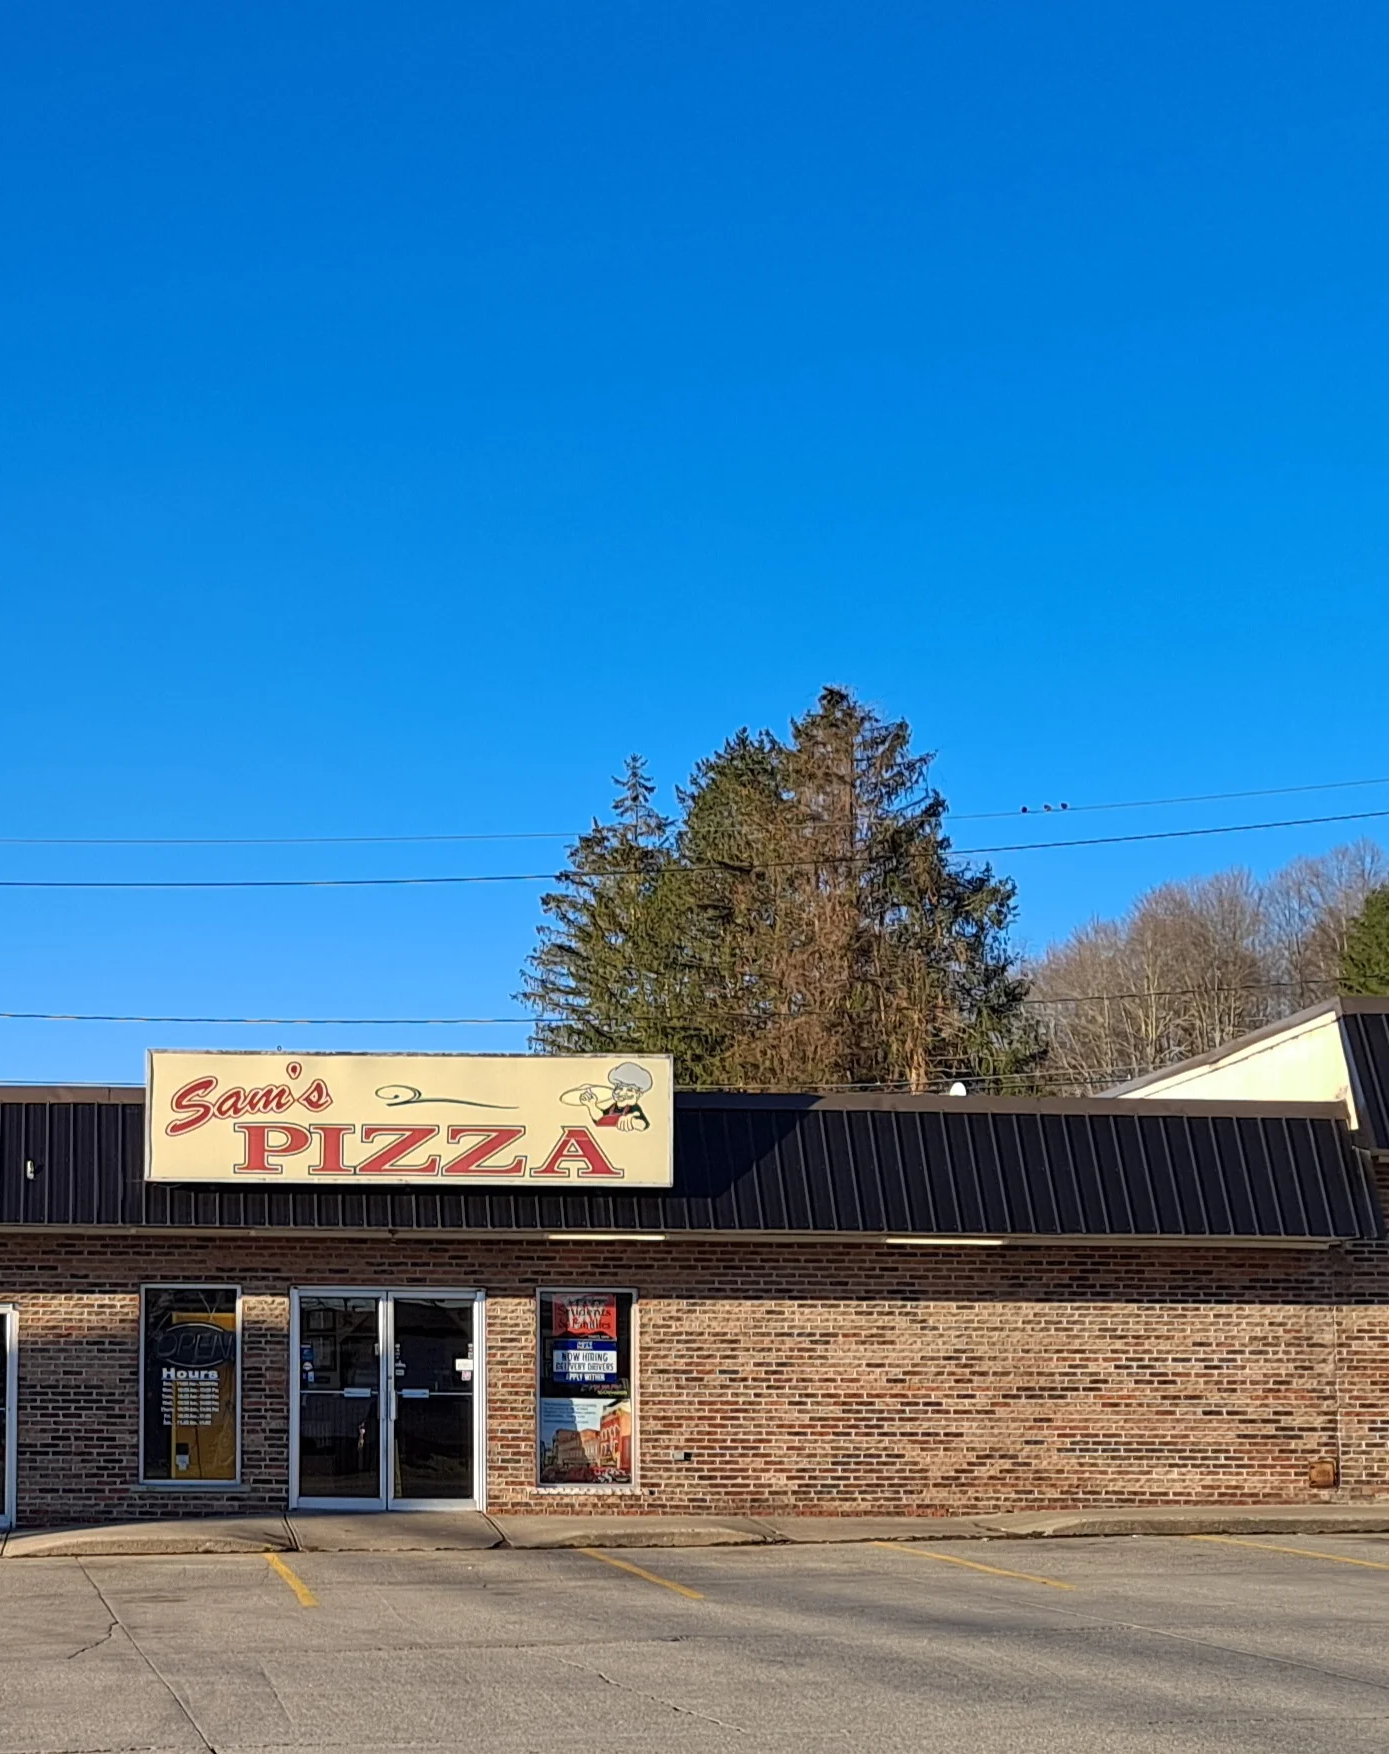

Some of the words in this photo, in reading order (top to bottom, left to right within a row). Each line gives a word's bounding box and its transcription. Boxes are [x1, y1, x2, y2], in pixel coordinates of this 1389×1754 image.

[165, 1061, 333, 1137] Sam's
[233, 1123, 625, 1179] PIZZA
[157, 1332, 233, 1359] OPEN
[561, 1352, 580, 1362] NOW
[582, 1352, 608, 1363] HIRING
[161, 1367, 219, 1379] Hours
